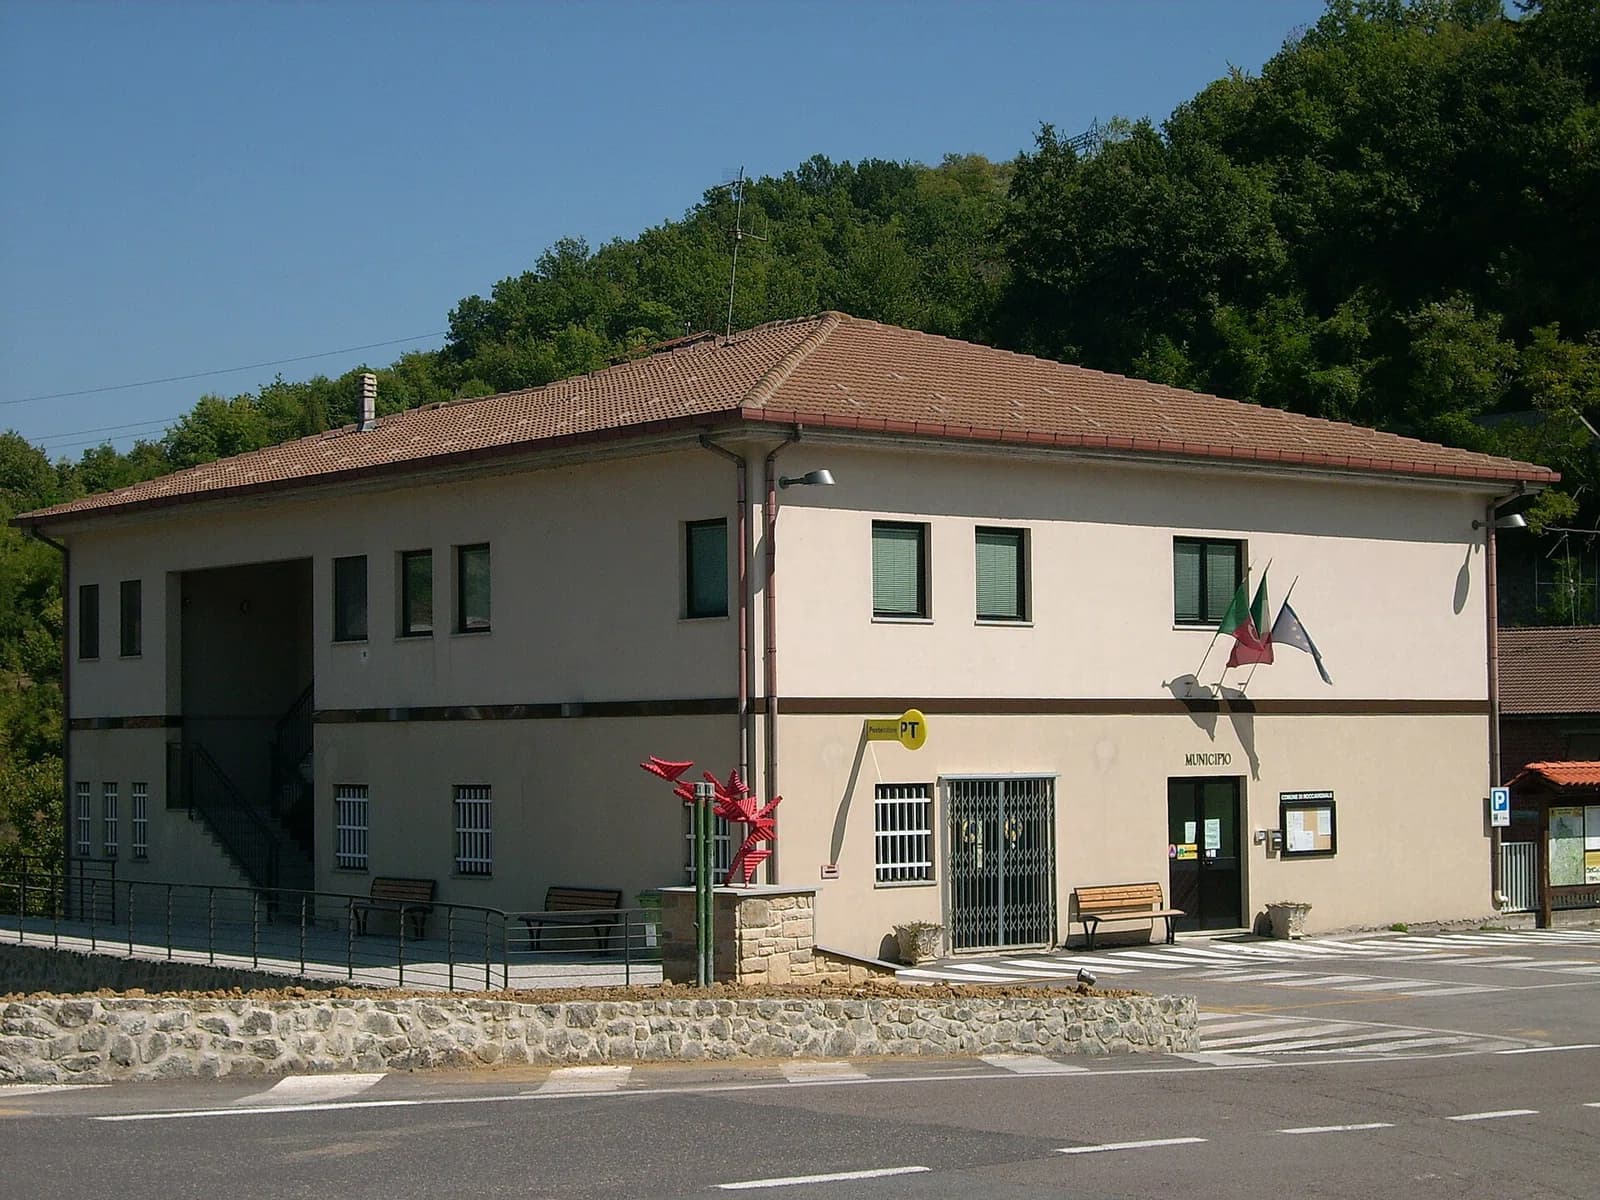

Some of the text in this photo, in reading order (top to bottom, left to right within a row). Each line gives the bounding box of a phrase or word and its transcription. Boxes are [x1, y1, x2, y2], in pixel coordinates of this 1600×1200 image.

[900, 721, 920, 739] PT
[1184, 753, 1232, 766] MUNICIPIO
[1494, 791, 1506, 810] P
